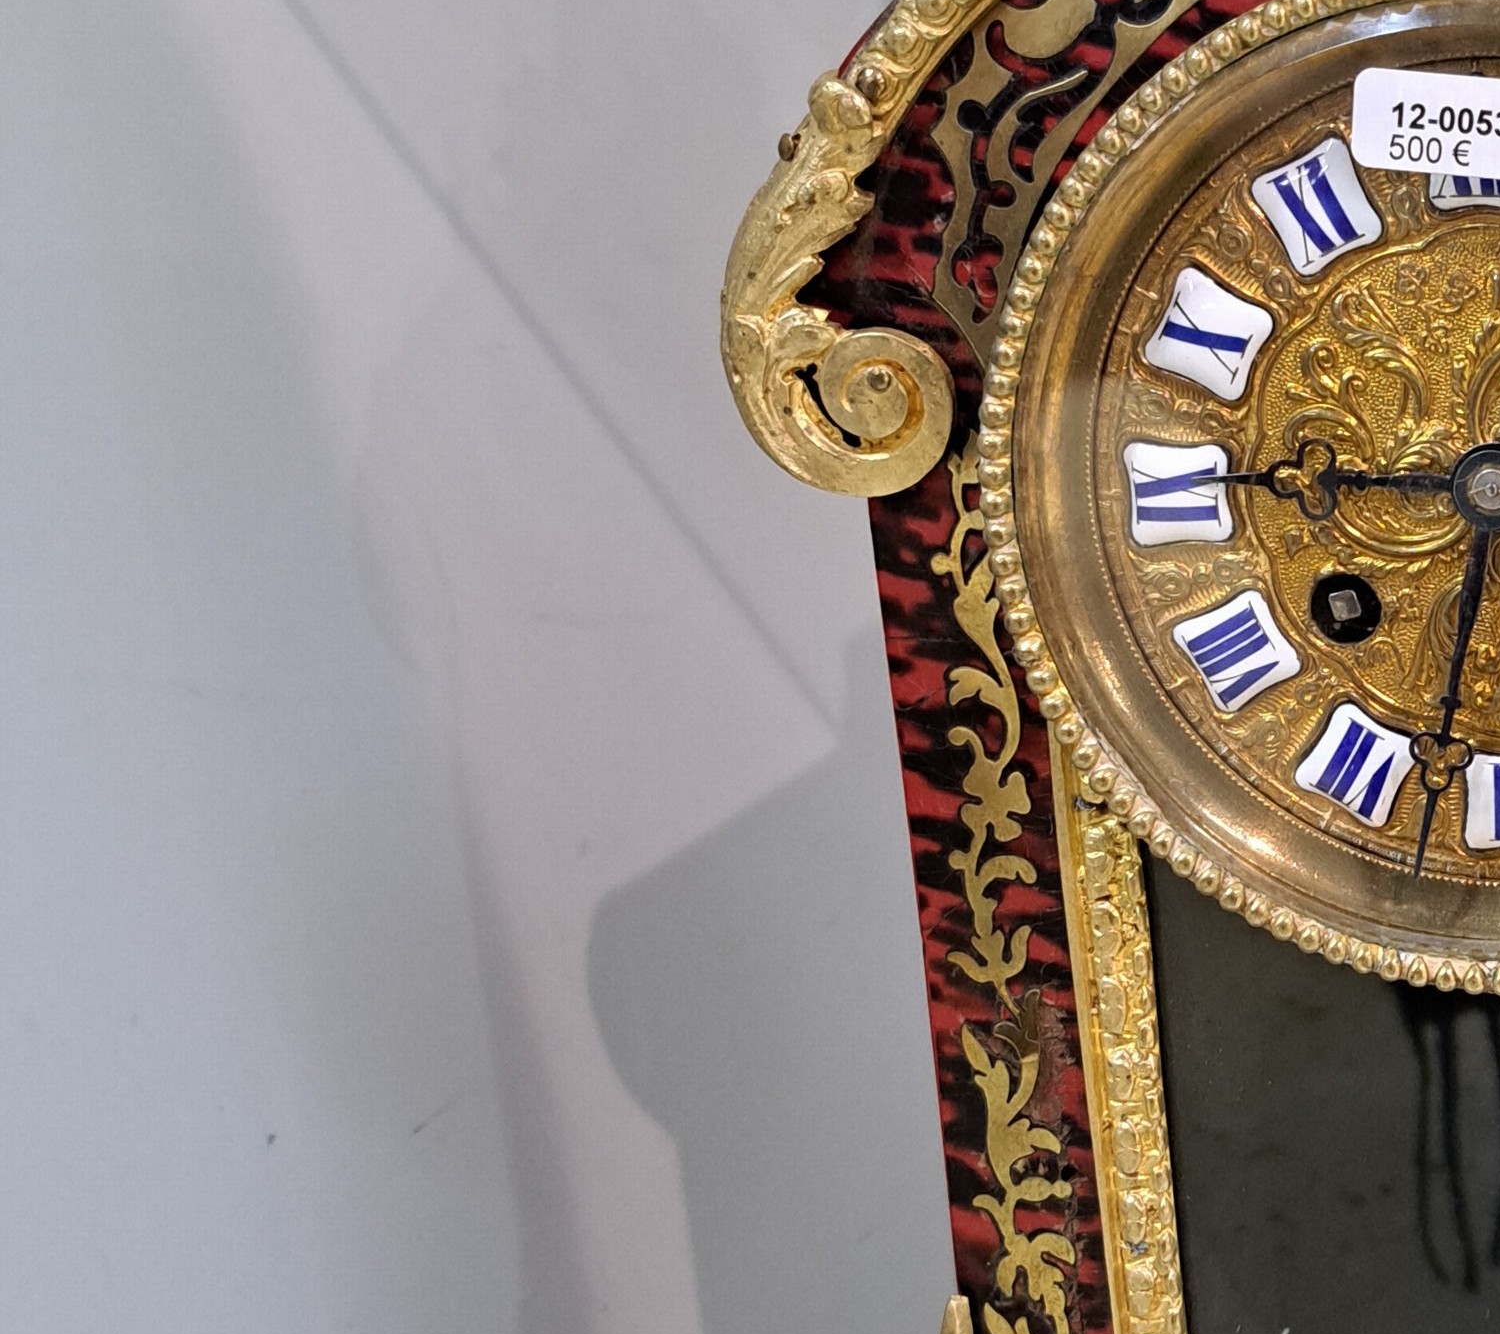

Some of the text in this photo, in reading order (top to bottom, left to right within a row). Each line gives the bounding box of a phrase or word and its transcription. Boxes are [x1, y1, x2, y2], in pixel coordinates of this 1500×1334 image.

[1389, 134, 1472, 167] 500 €
[1266, 153, 1366, 268] XI
[1158, 291, 1254, 385] X
